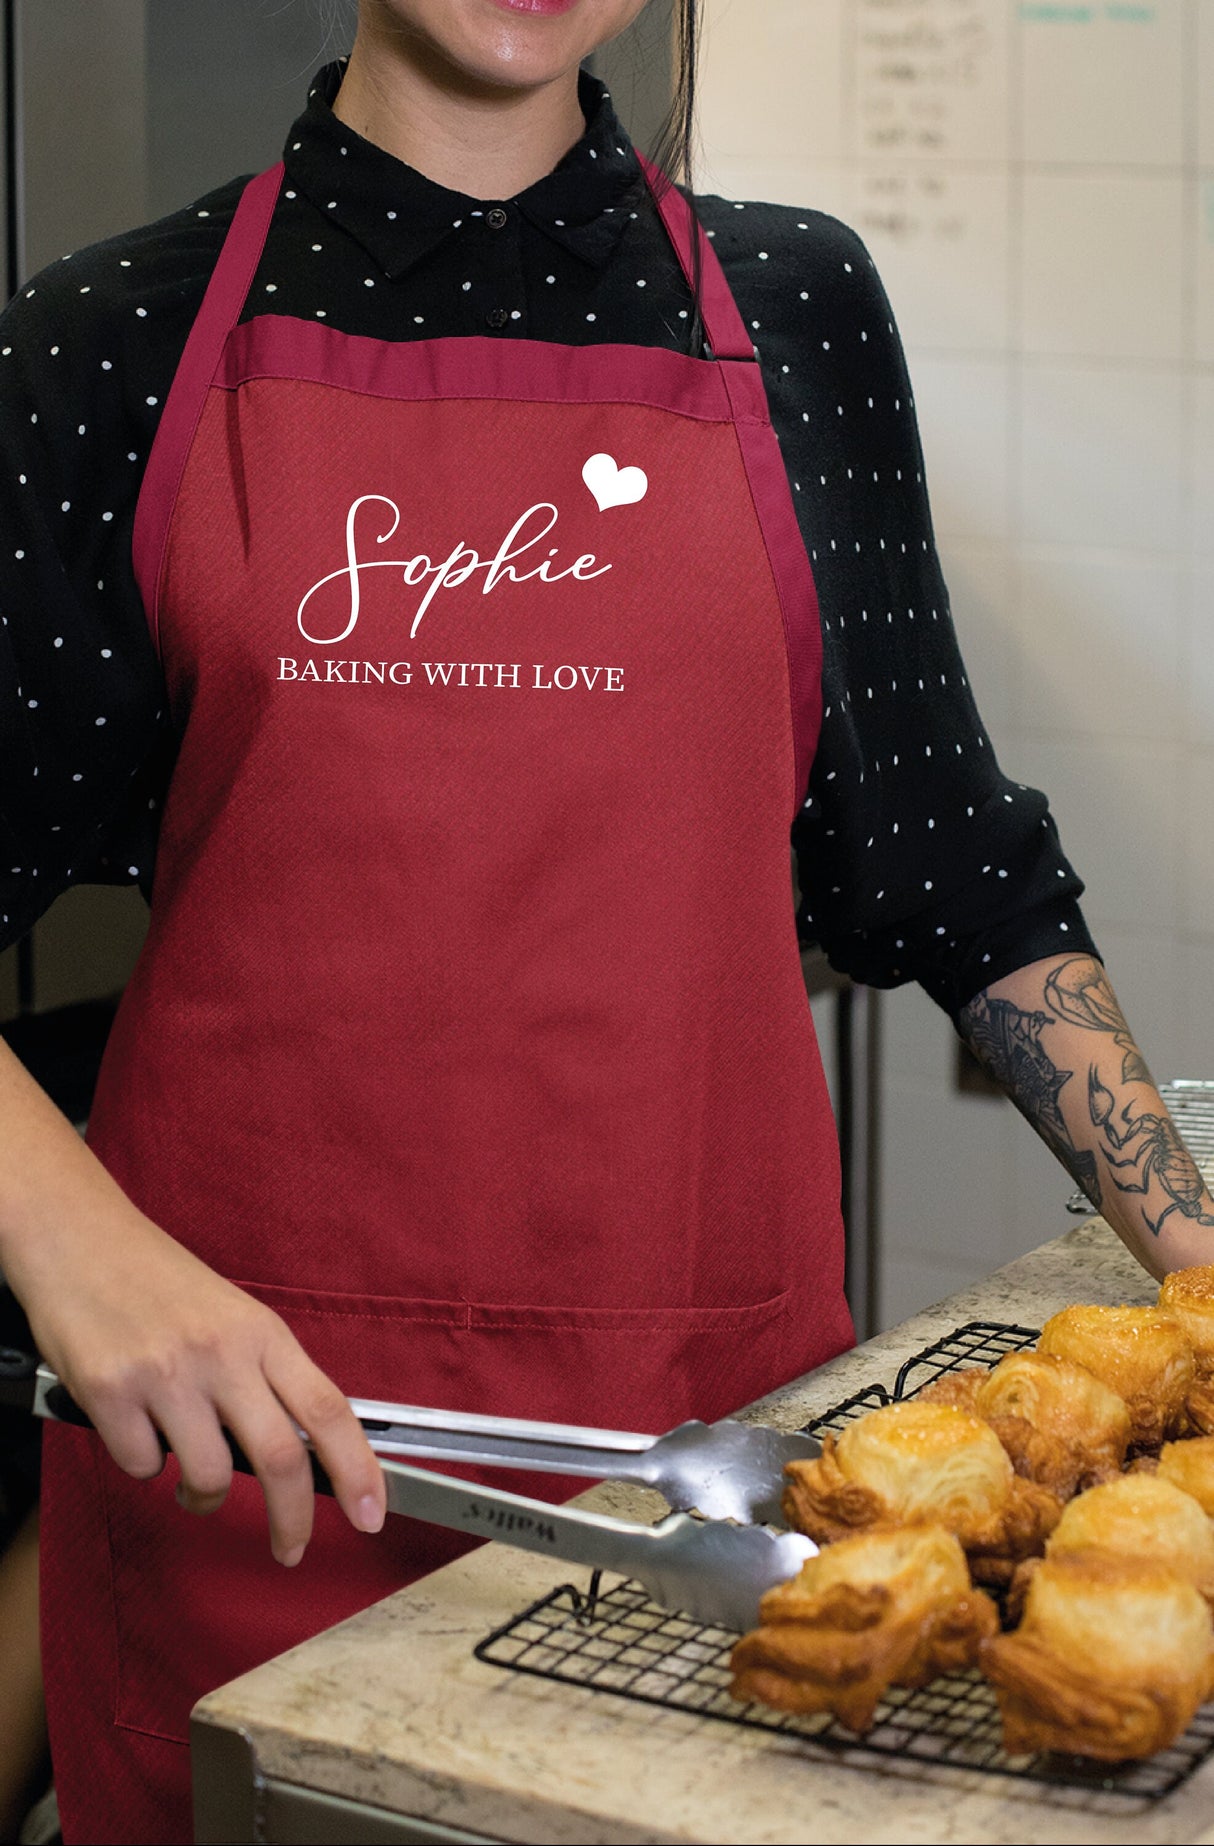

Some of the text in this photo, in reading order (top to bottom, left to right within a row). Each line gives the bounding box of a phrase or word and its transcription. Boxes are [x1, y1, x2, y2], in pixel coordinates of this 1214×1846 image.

[296, 493, 613, 645] Sophie
[275, 656, 626, 693] BAKING WITH LOVE
